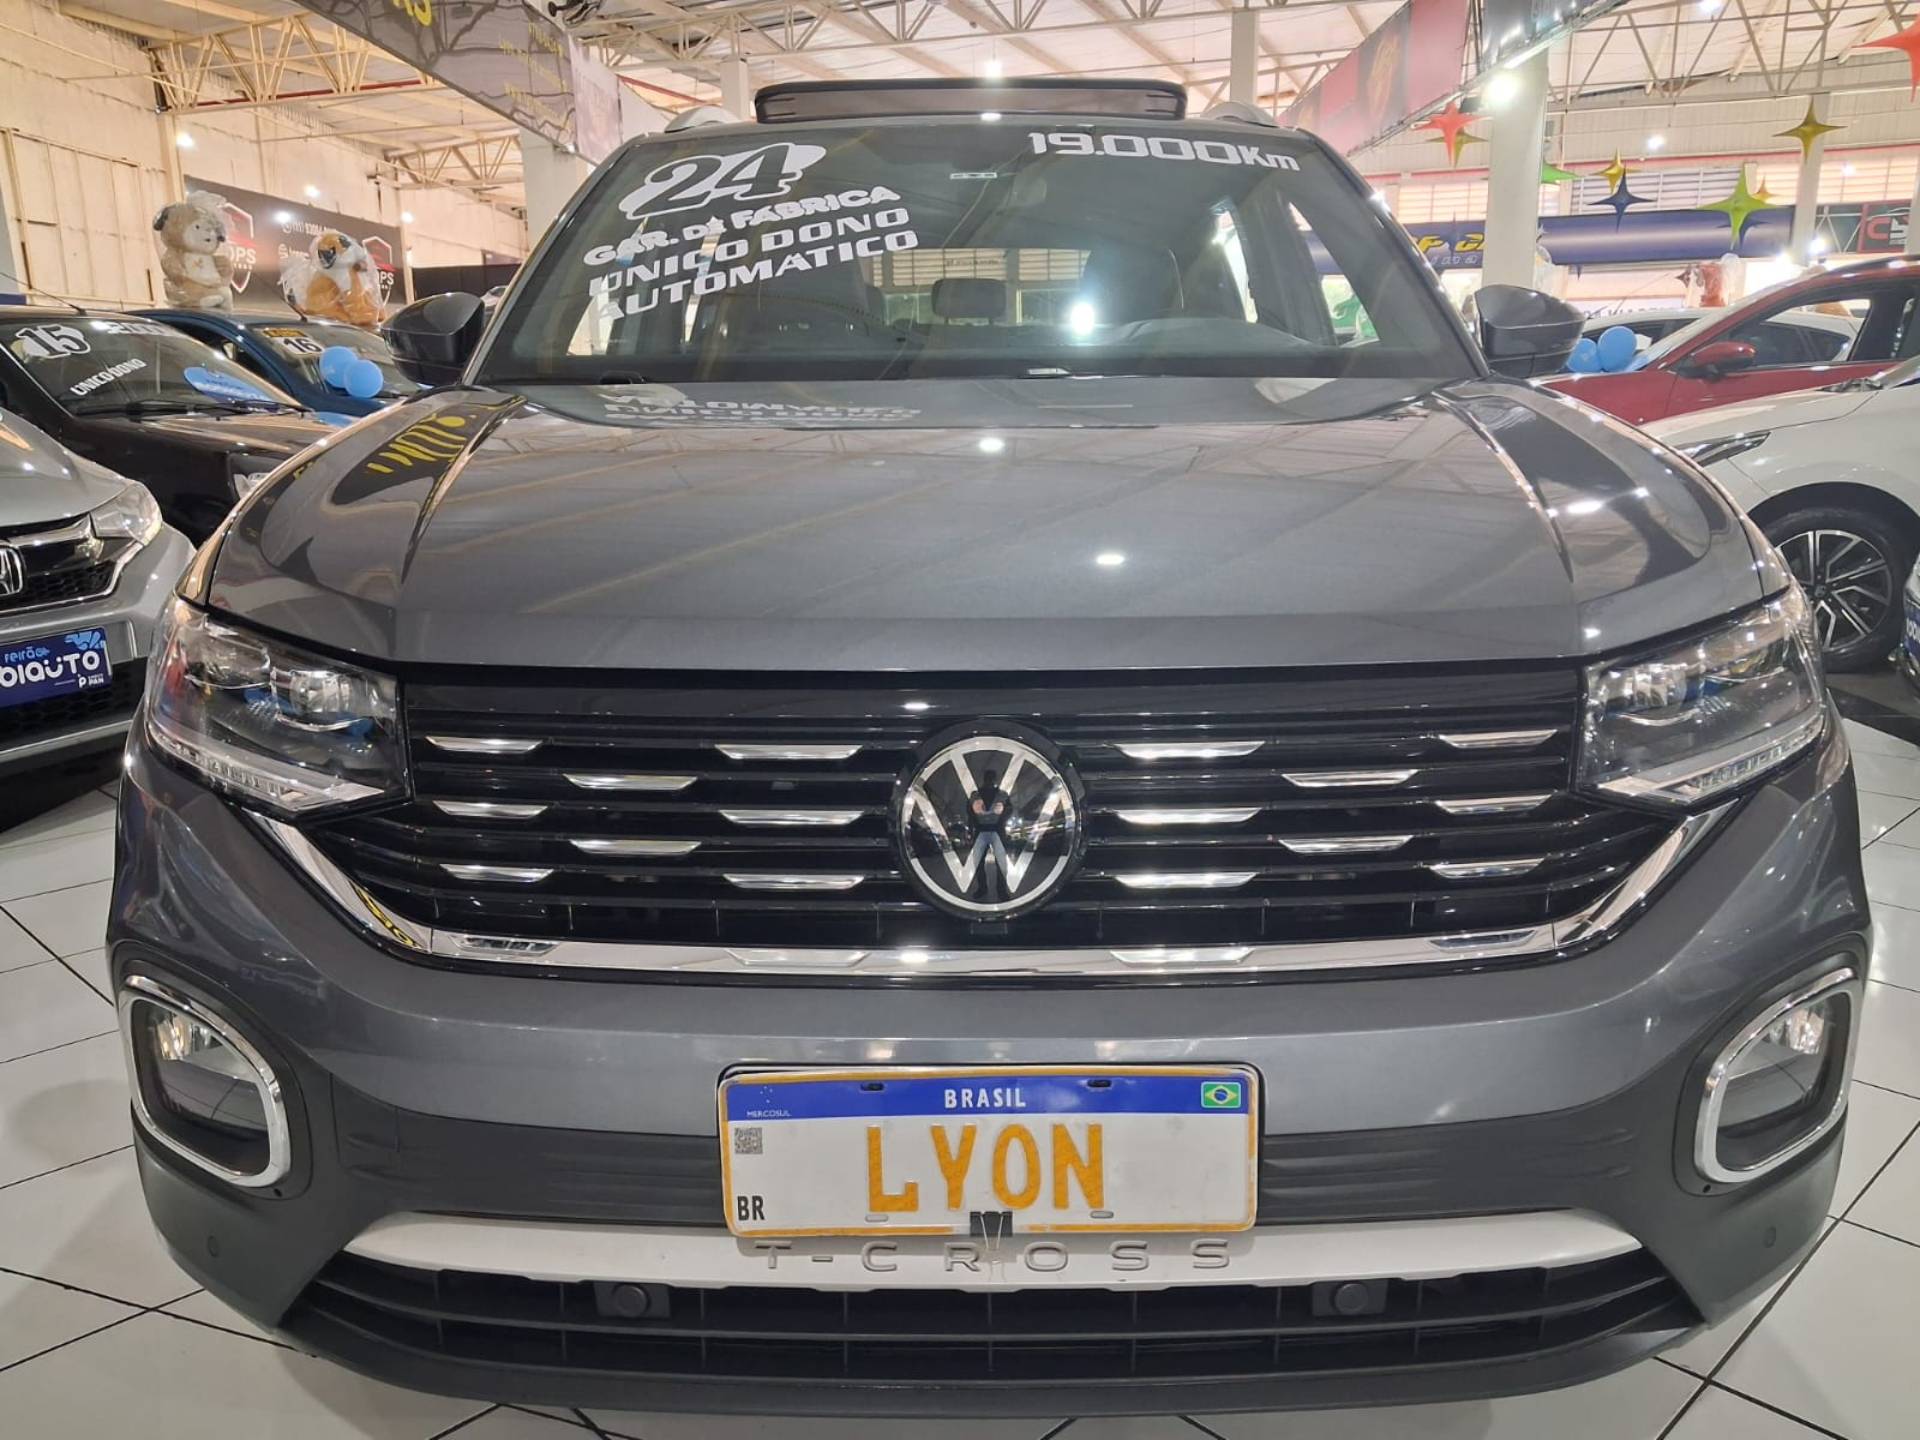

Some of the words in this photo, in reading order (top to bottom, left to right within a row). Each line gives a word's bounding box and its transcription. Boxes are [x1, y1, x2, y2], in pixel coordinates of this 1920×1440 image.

[618, 142, 827, 220] 24
[761, 207, 910, 253] DONO
[16, 324, 91, 359] 15
[283, 337, 323, 353] 16
[69, 370, 115, 396] UNICO
[109, 357, 148, 378] DONO
[746, 1109, 793, 1118] MERCOSUL
[944, 1087, 1027, 1109] BRASIL
[866, 1123, 1106, 1213] LYON
[736, 1195, 766, 1222] BR
[754, 1239, 1231, 1273] T-CROSS
